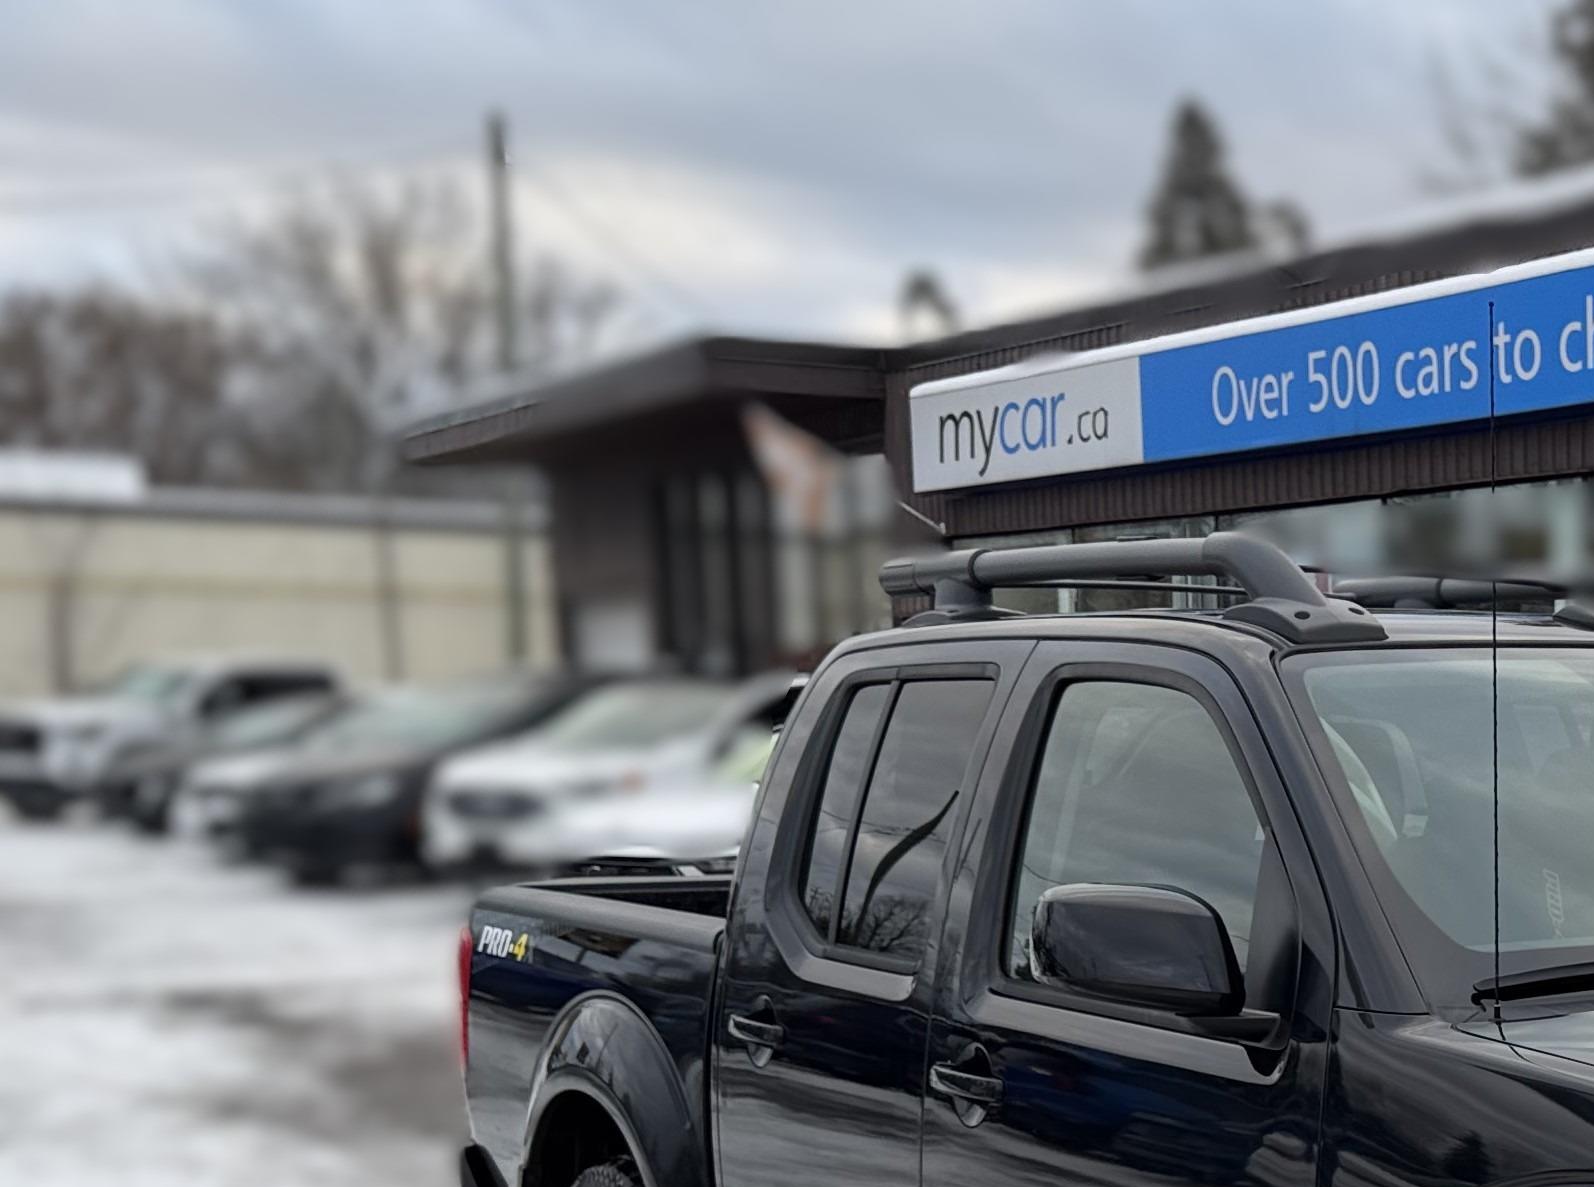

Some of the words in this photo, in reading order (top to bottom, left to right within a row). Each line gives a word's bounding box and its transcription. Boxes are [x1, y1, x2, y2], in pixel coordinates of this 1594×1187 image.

[1211, 365, 1295, 426] Over
[1307, 341, 1380, 414] 500
[1394, 338, 1480, 400] cars
[1493, 321, 1542, 384] to
[938, 390, 1110, 478] mycar.ca
